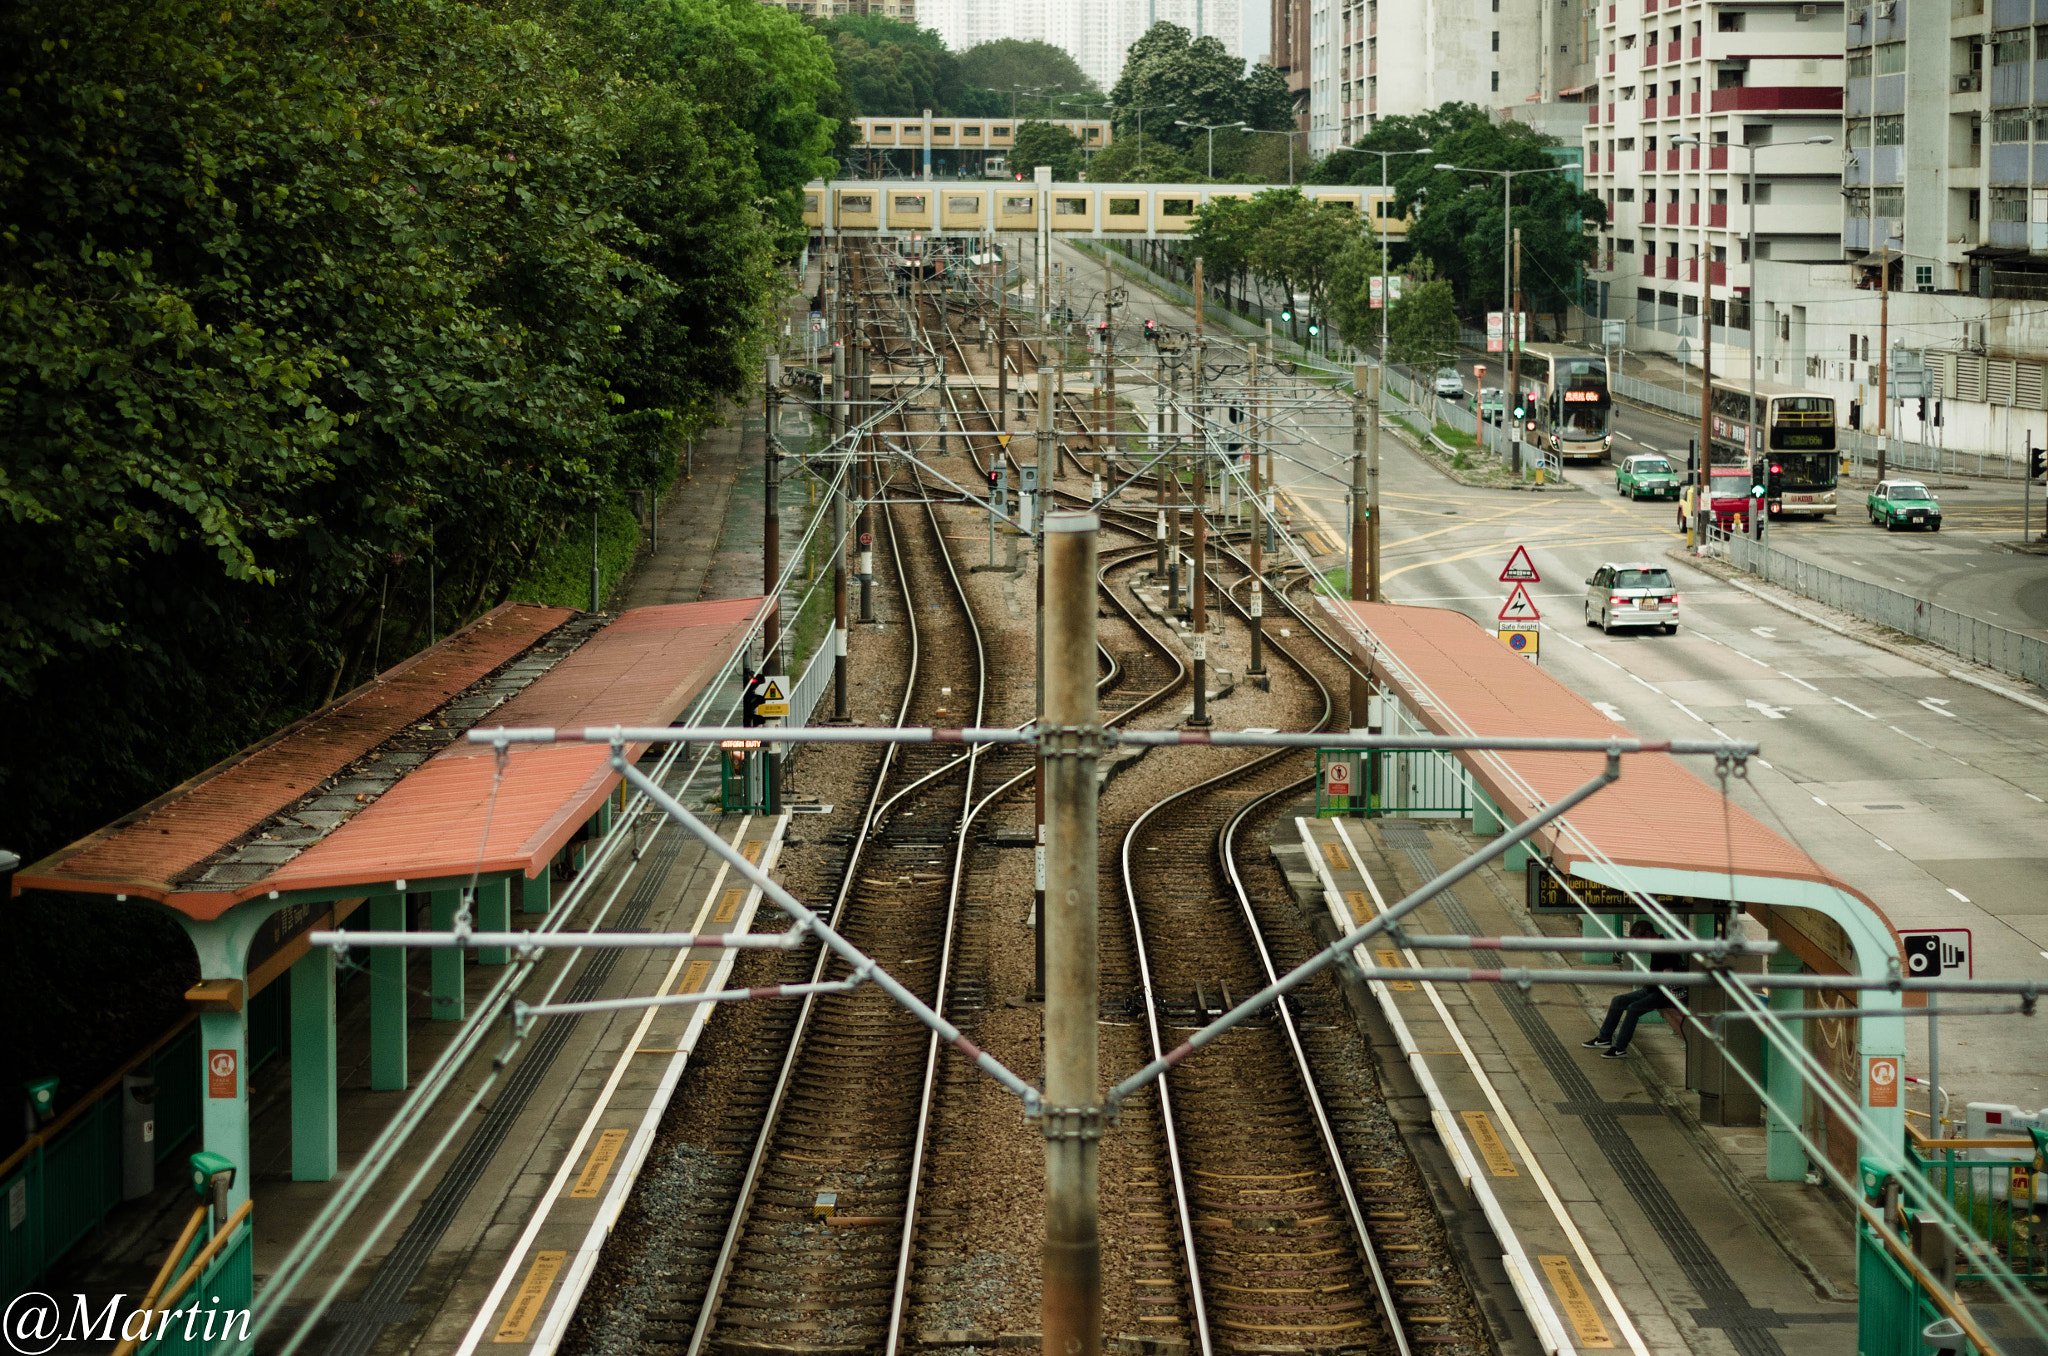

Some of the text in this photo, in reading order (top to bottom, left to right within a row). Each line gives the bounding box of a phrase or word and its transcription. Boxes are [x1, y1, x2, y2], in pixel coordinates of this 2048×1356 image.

[1517, 623, 1537, 632] height
[1541, 890, 1557, 904] 610
[1585, 890, 1600, 904] Mun
[1601, 889, 1622, 904] Ferry
